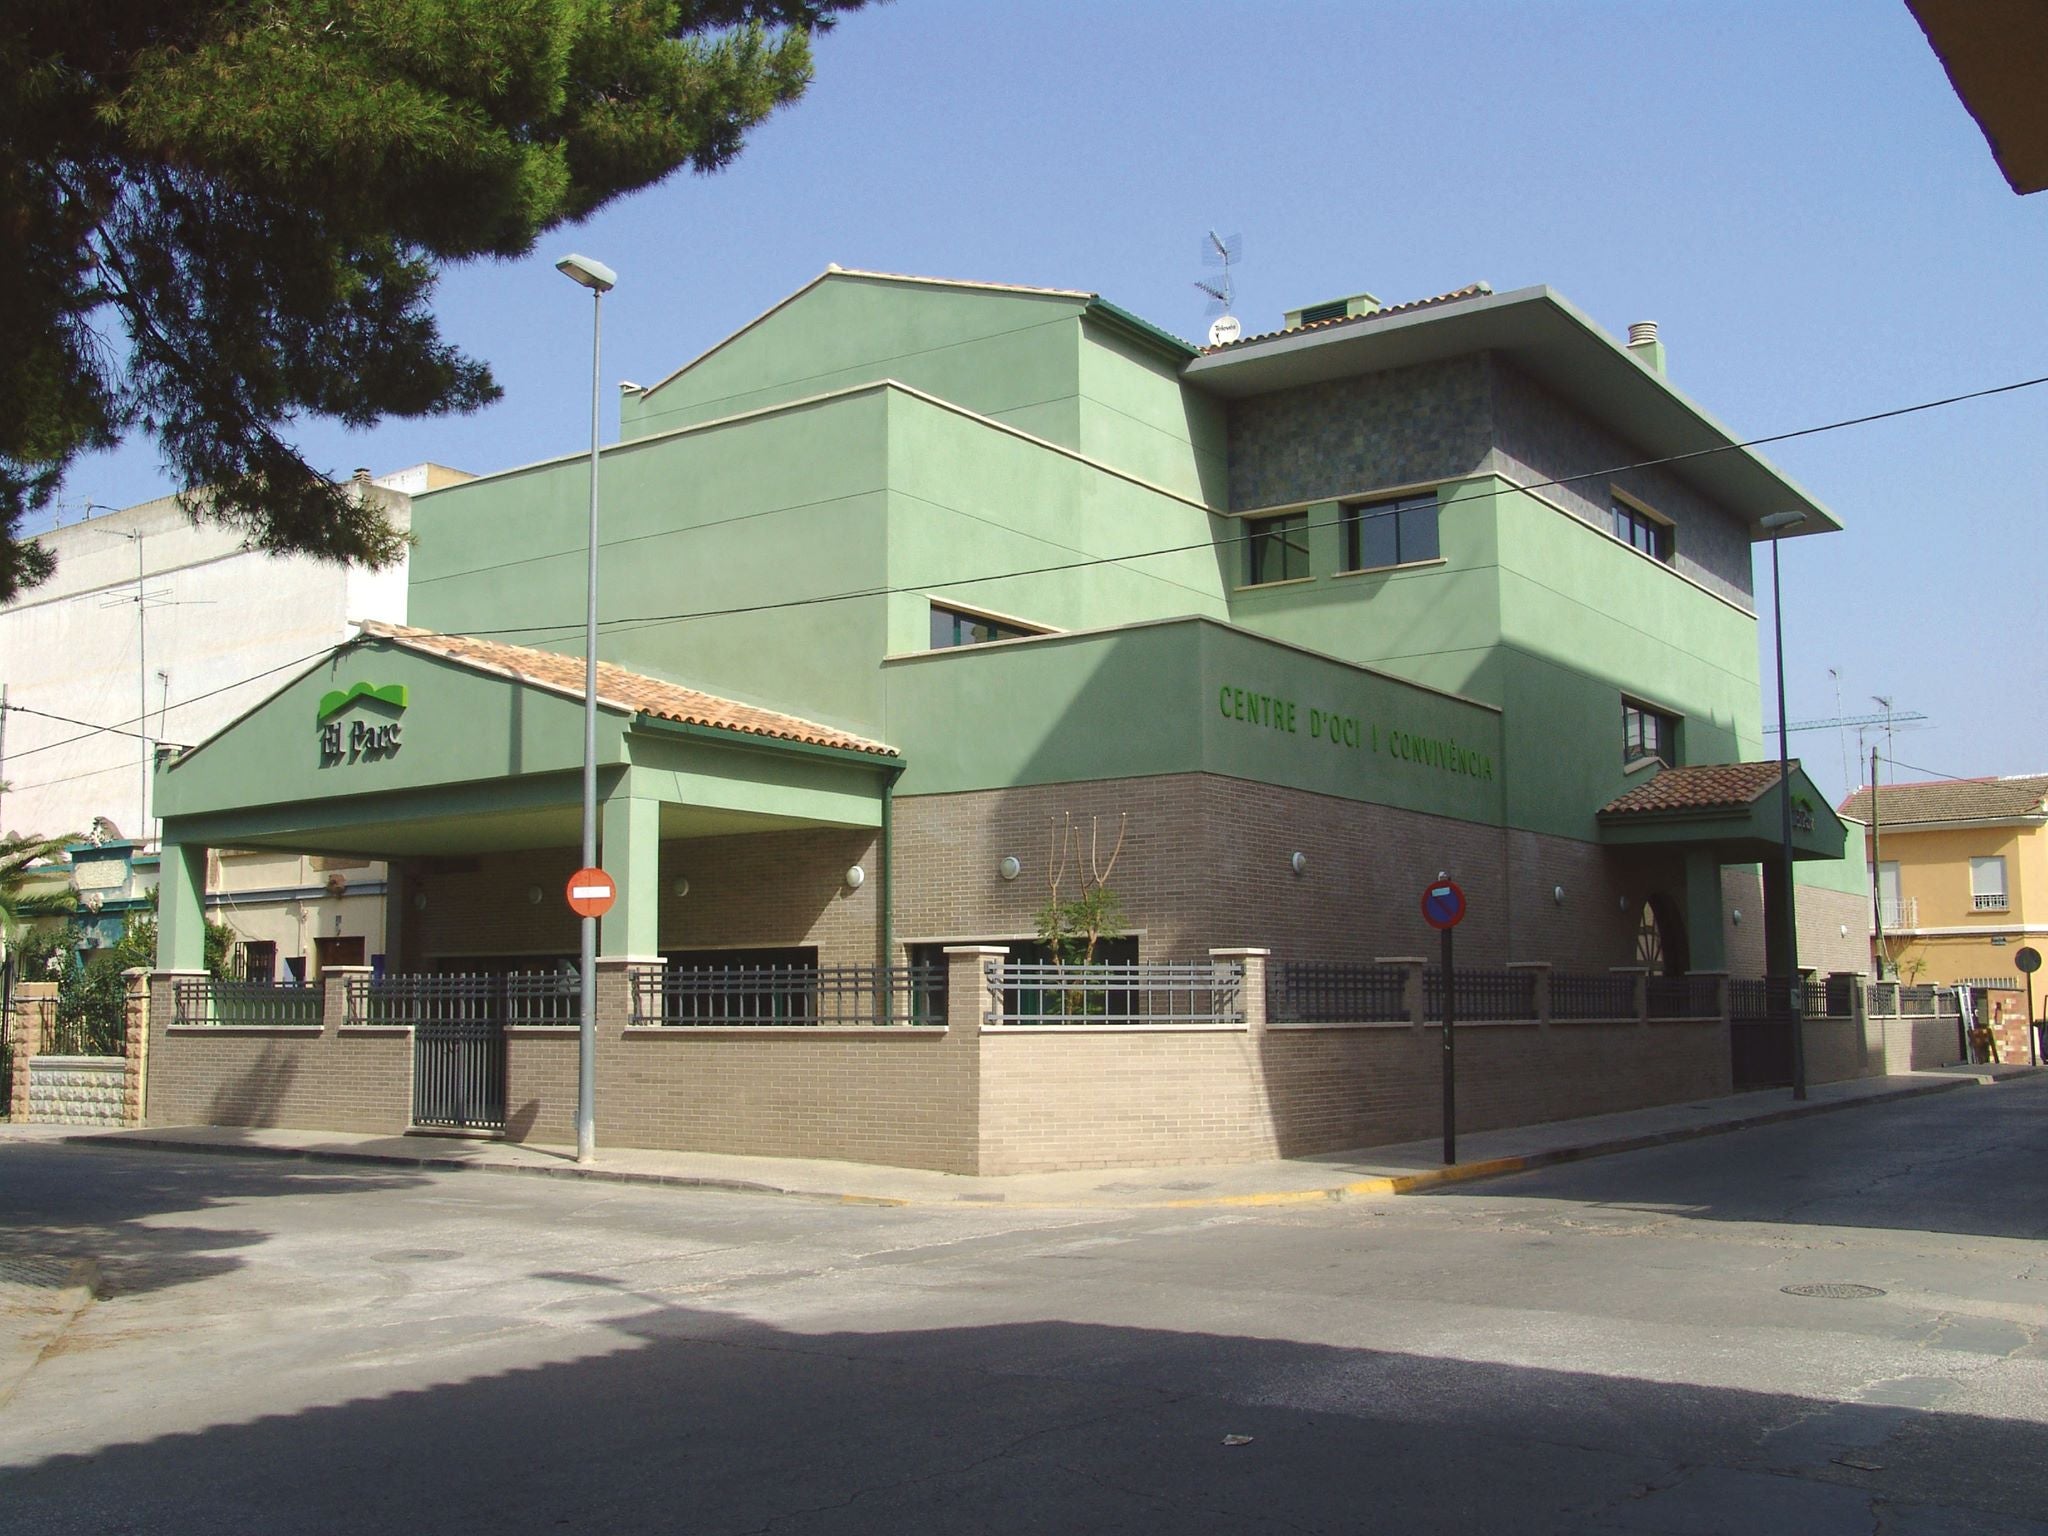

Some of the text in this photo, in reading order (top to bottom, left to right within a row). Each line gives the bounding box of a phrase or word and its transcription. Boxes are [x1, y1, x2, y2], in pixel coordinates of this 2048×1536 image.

[323, 720, 402, 754] El Parc
[1219, 685, 1493, 781] CENTRE D'OCI I CONVIVÈNCIA
